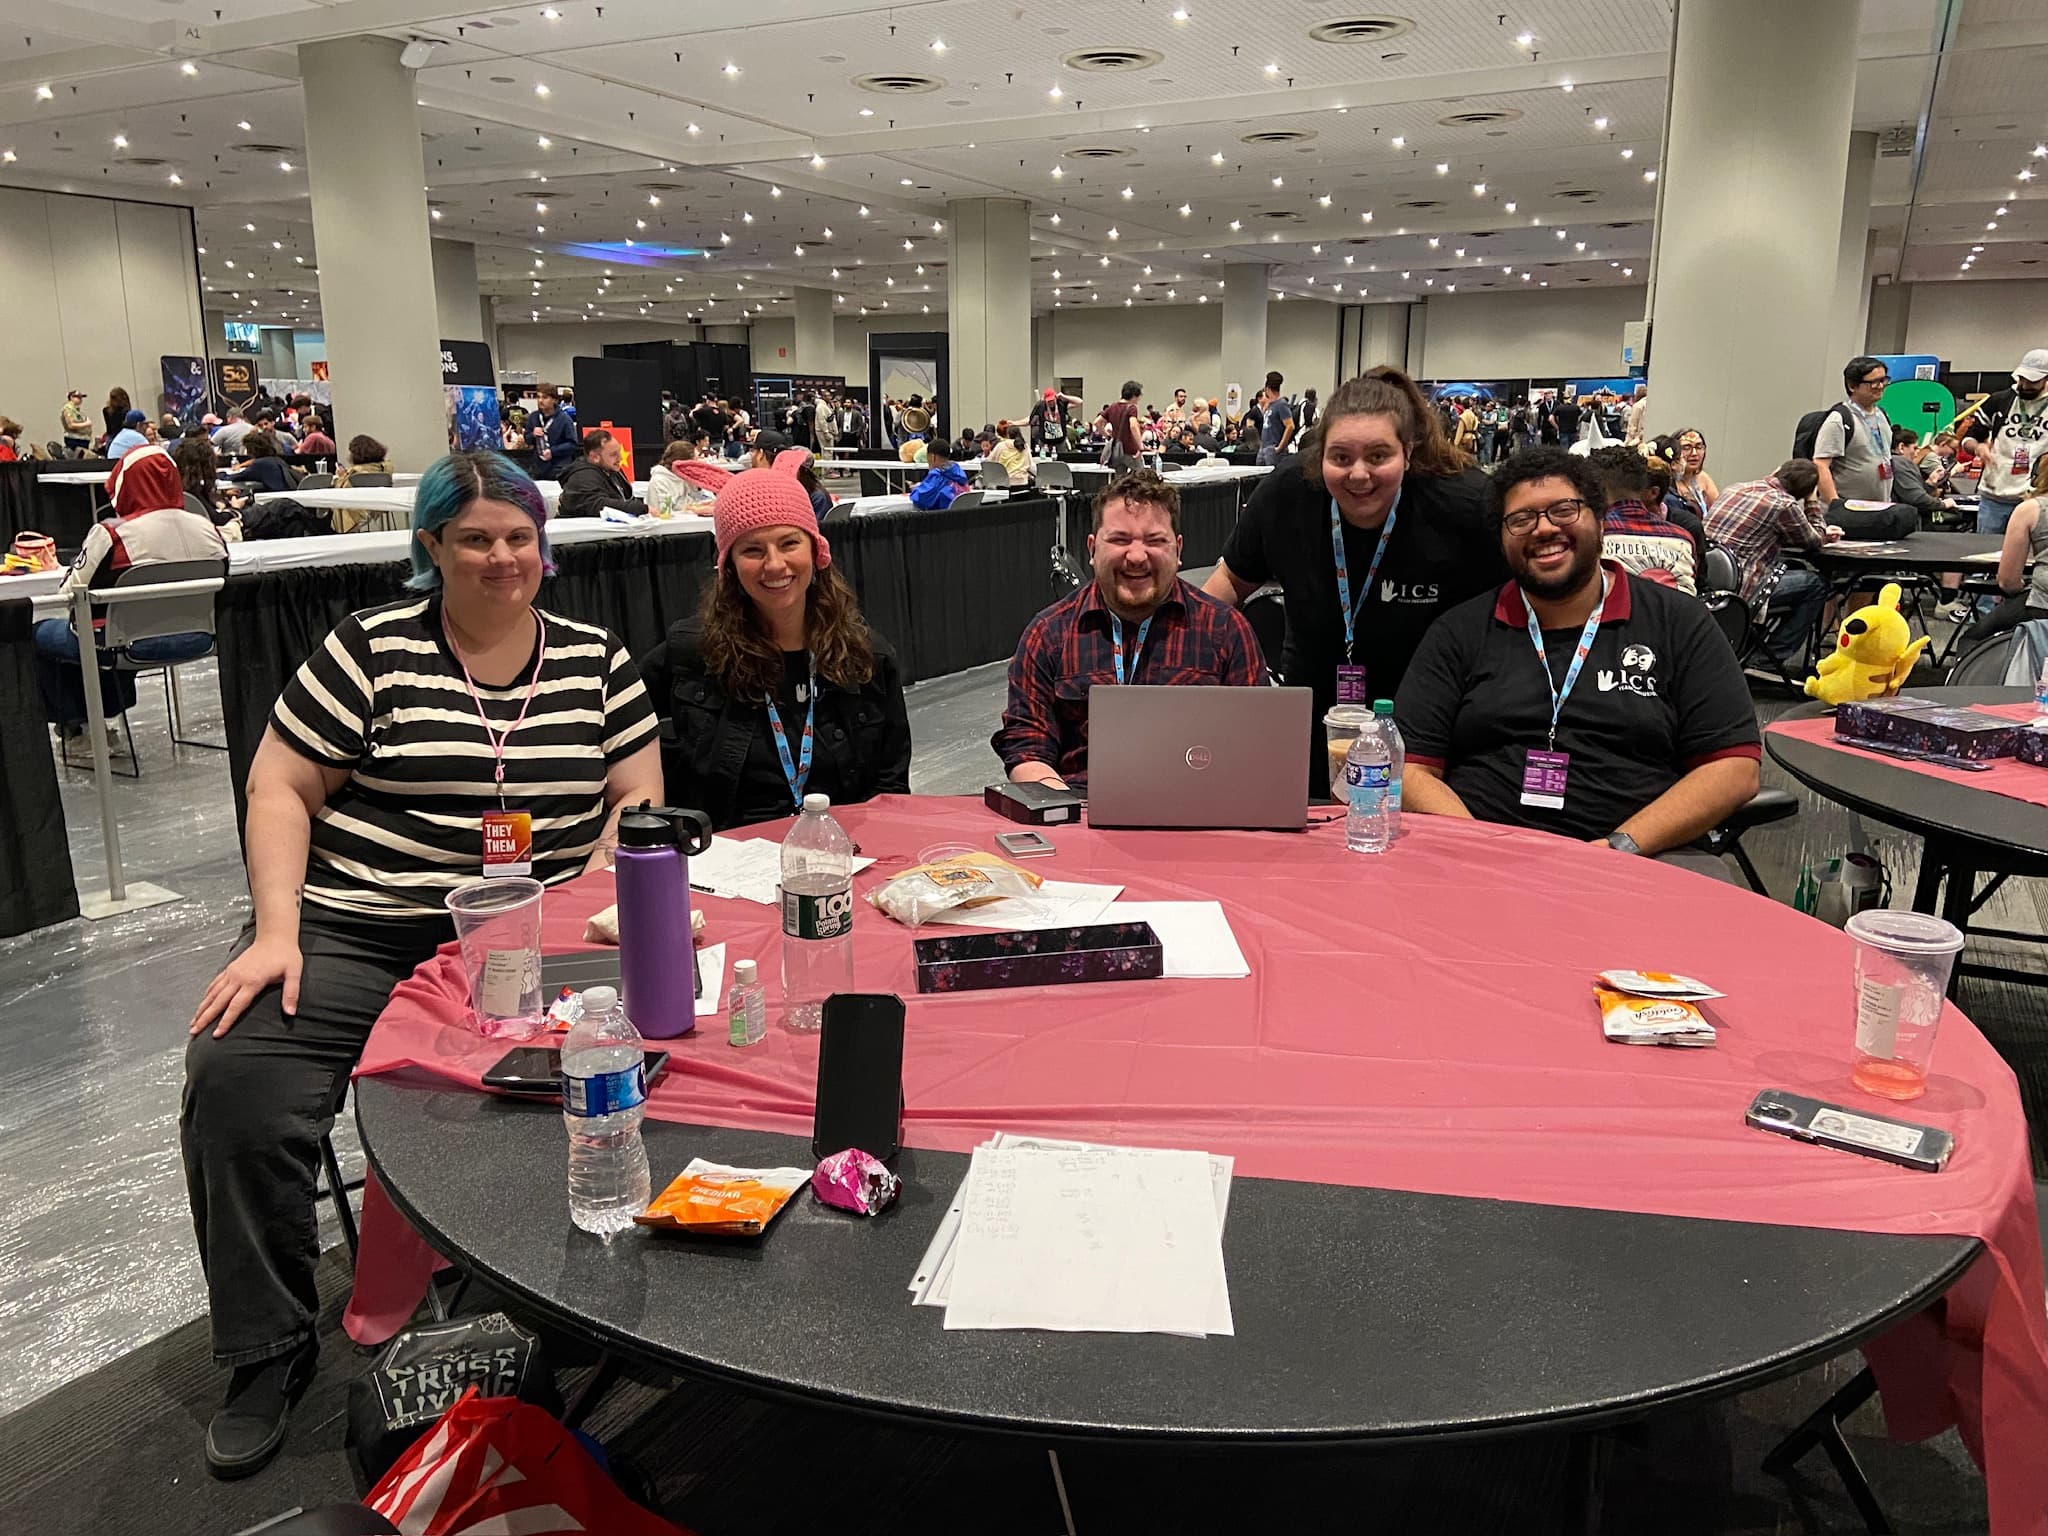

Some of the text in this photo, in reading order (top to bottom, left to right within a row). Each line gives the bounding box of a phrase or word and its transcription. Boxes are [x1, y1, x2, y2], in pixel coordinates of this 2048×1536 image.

[1401, 583, 1439, 598] ICS
[1620, 669, 1656, 691] ICS
[485, 823, 512, 838] THEY
[485, 839, 516, 853] THEM
